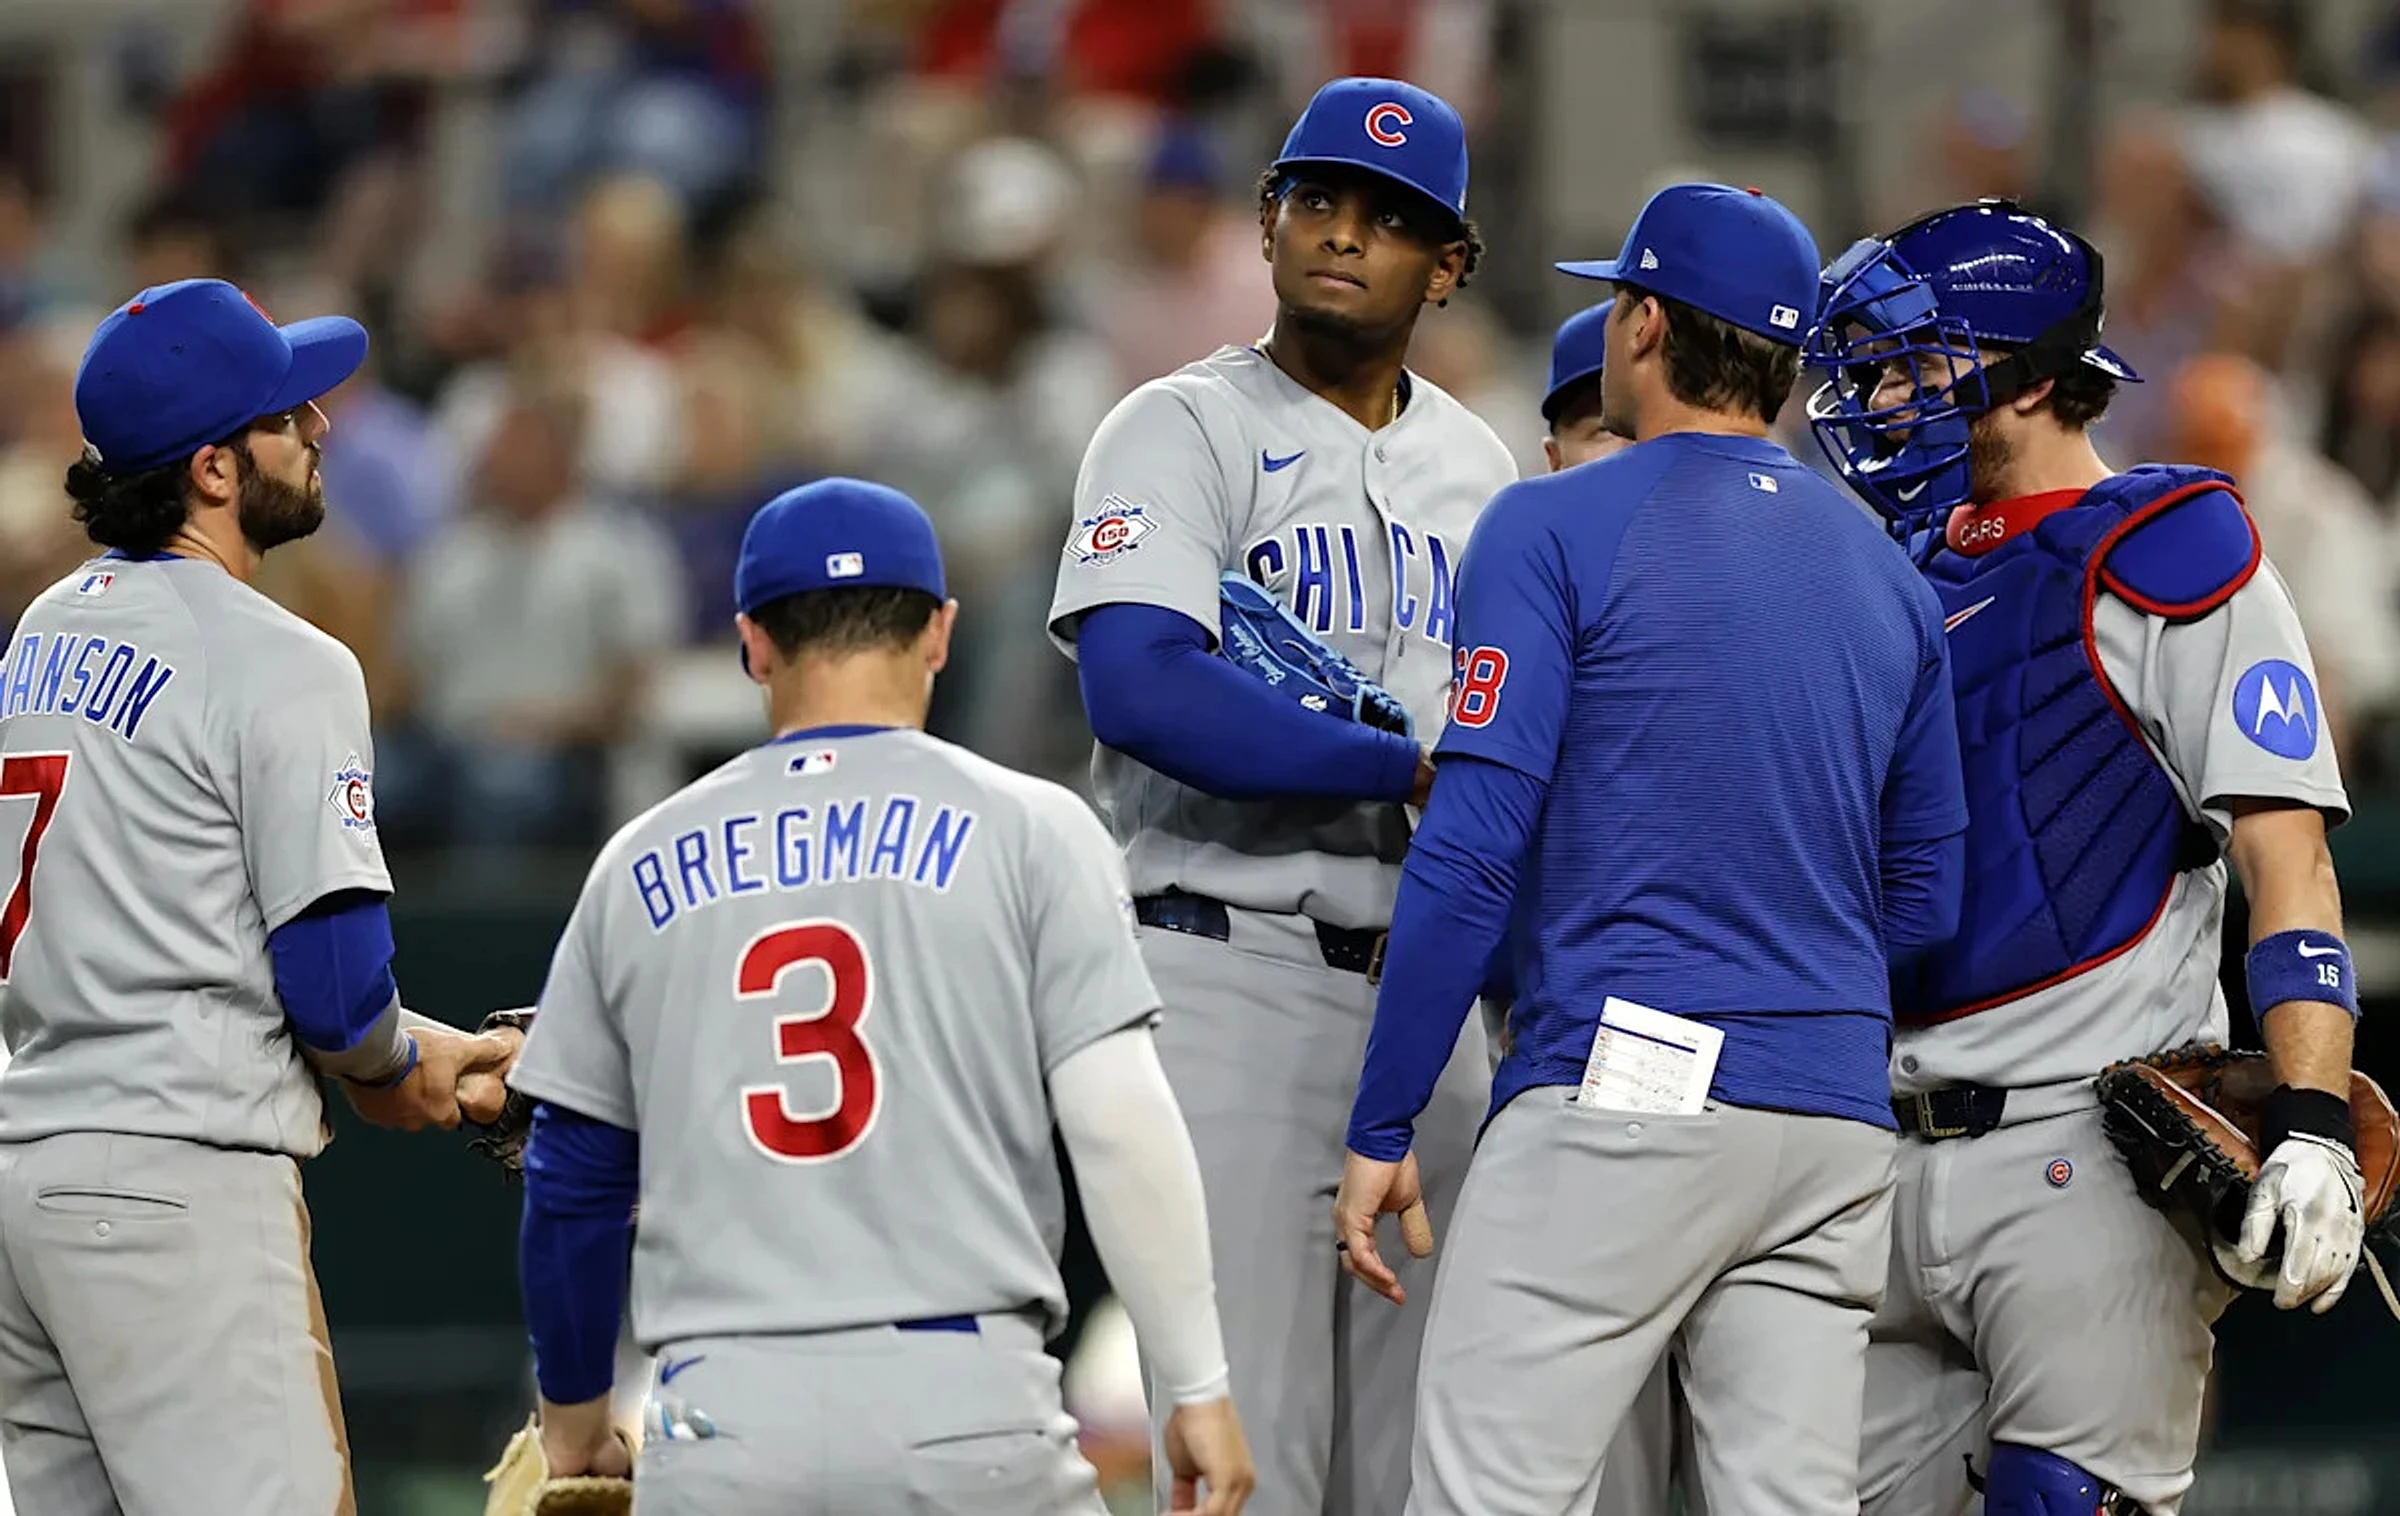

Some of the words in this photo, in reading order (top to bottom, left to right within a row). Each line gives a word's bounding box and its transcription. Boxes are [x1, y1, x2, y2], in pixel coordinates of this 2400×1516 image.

[1365, 102, 1413, 147] C
[631, 797, 977, 932] BREGMAN
[2317, 963, 2340, 988] 15
[734, 917, 884, 1165] 3
